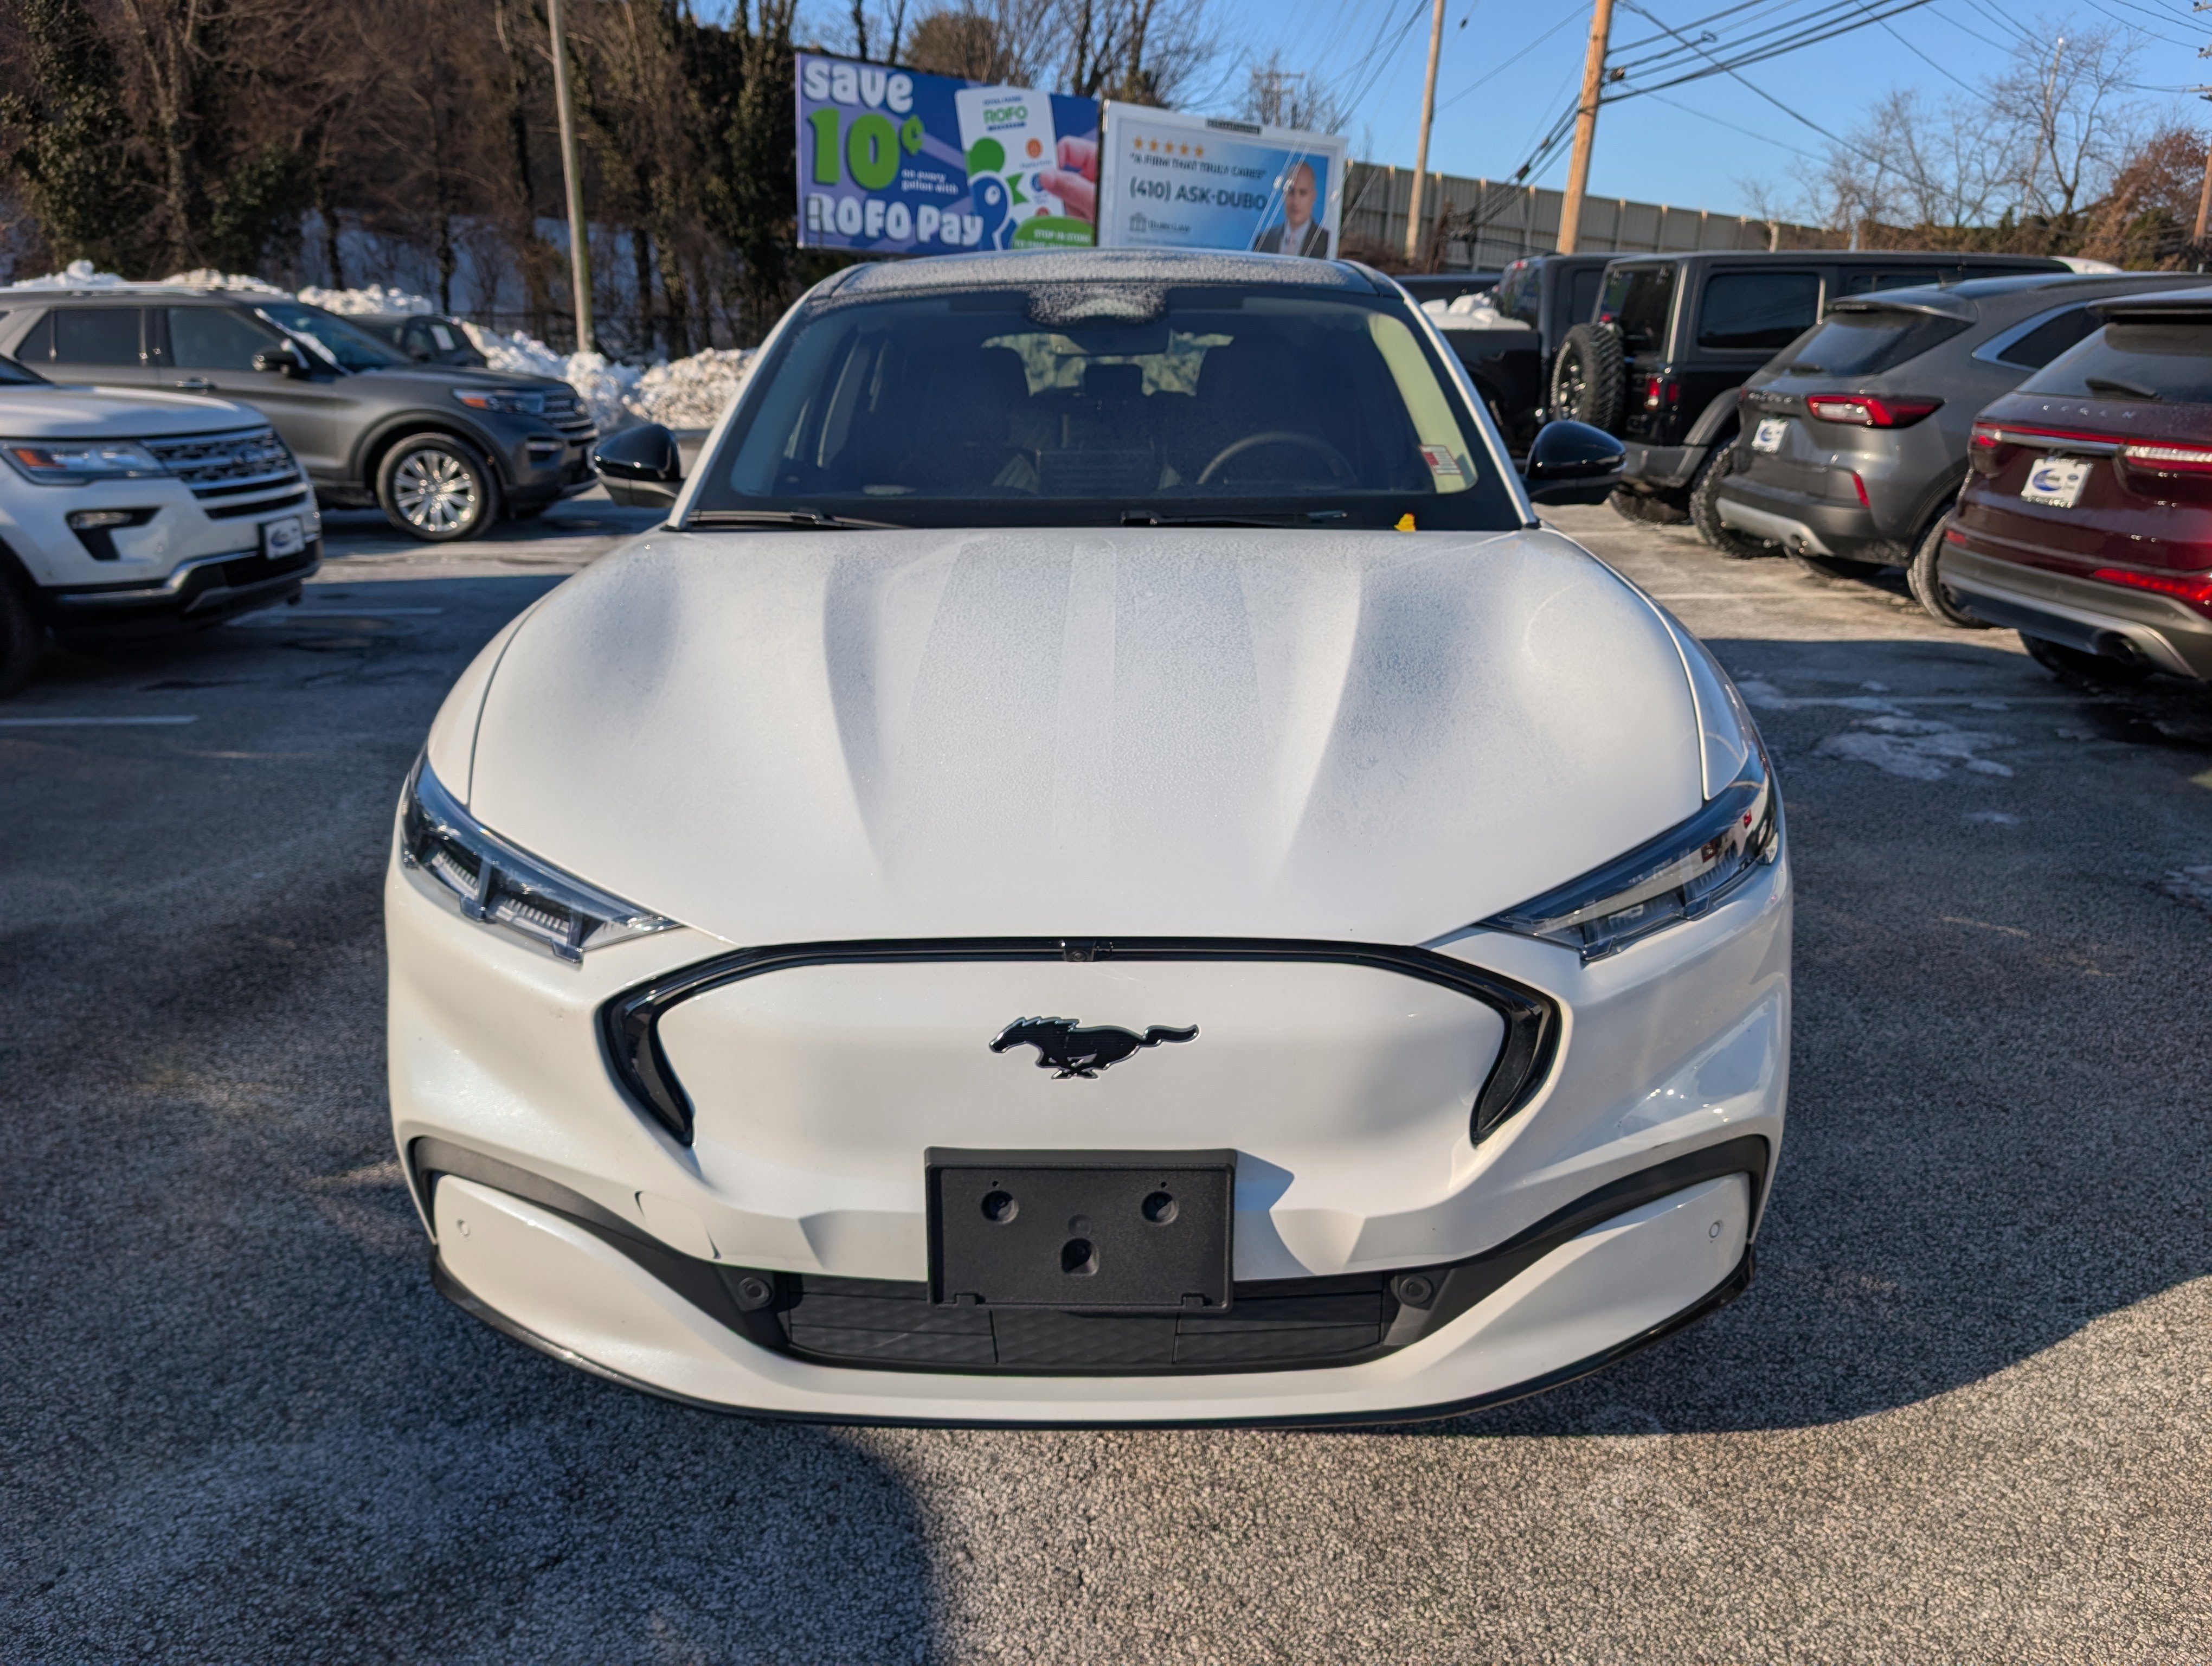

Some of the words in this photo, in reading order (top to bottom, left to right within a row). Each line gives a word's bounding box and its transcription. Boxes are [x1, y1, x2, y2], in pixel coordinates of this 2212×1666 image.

[1172, 158, 1197, 170] THAT
[901, 169, 916, 178] on
[916, 171, 947, 183] every
[901, 180, 934, 192] gallon
[934, 182, 959, 195] with
[1130, 176, 1172, 202] (410)
[807, 193, 911, 240] ROFO
[916, 204, 984, 246] Pay
